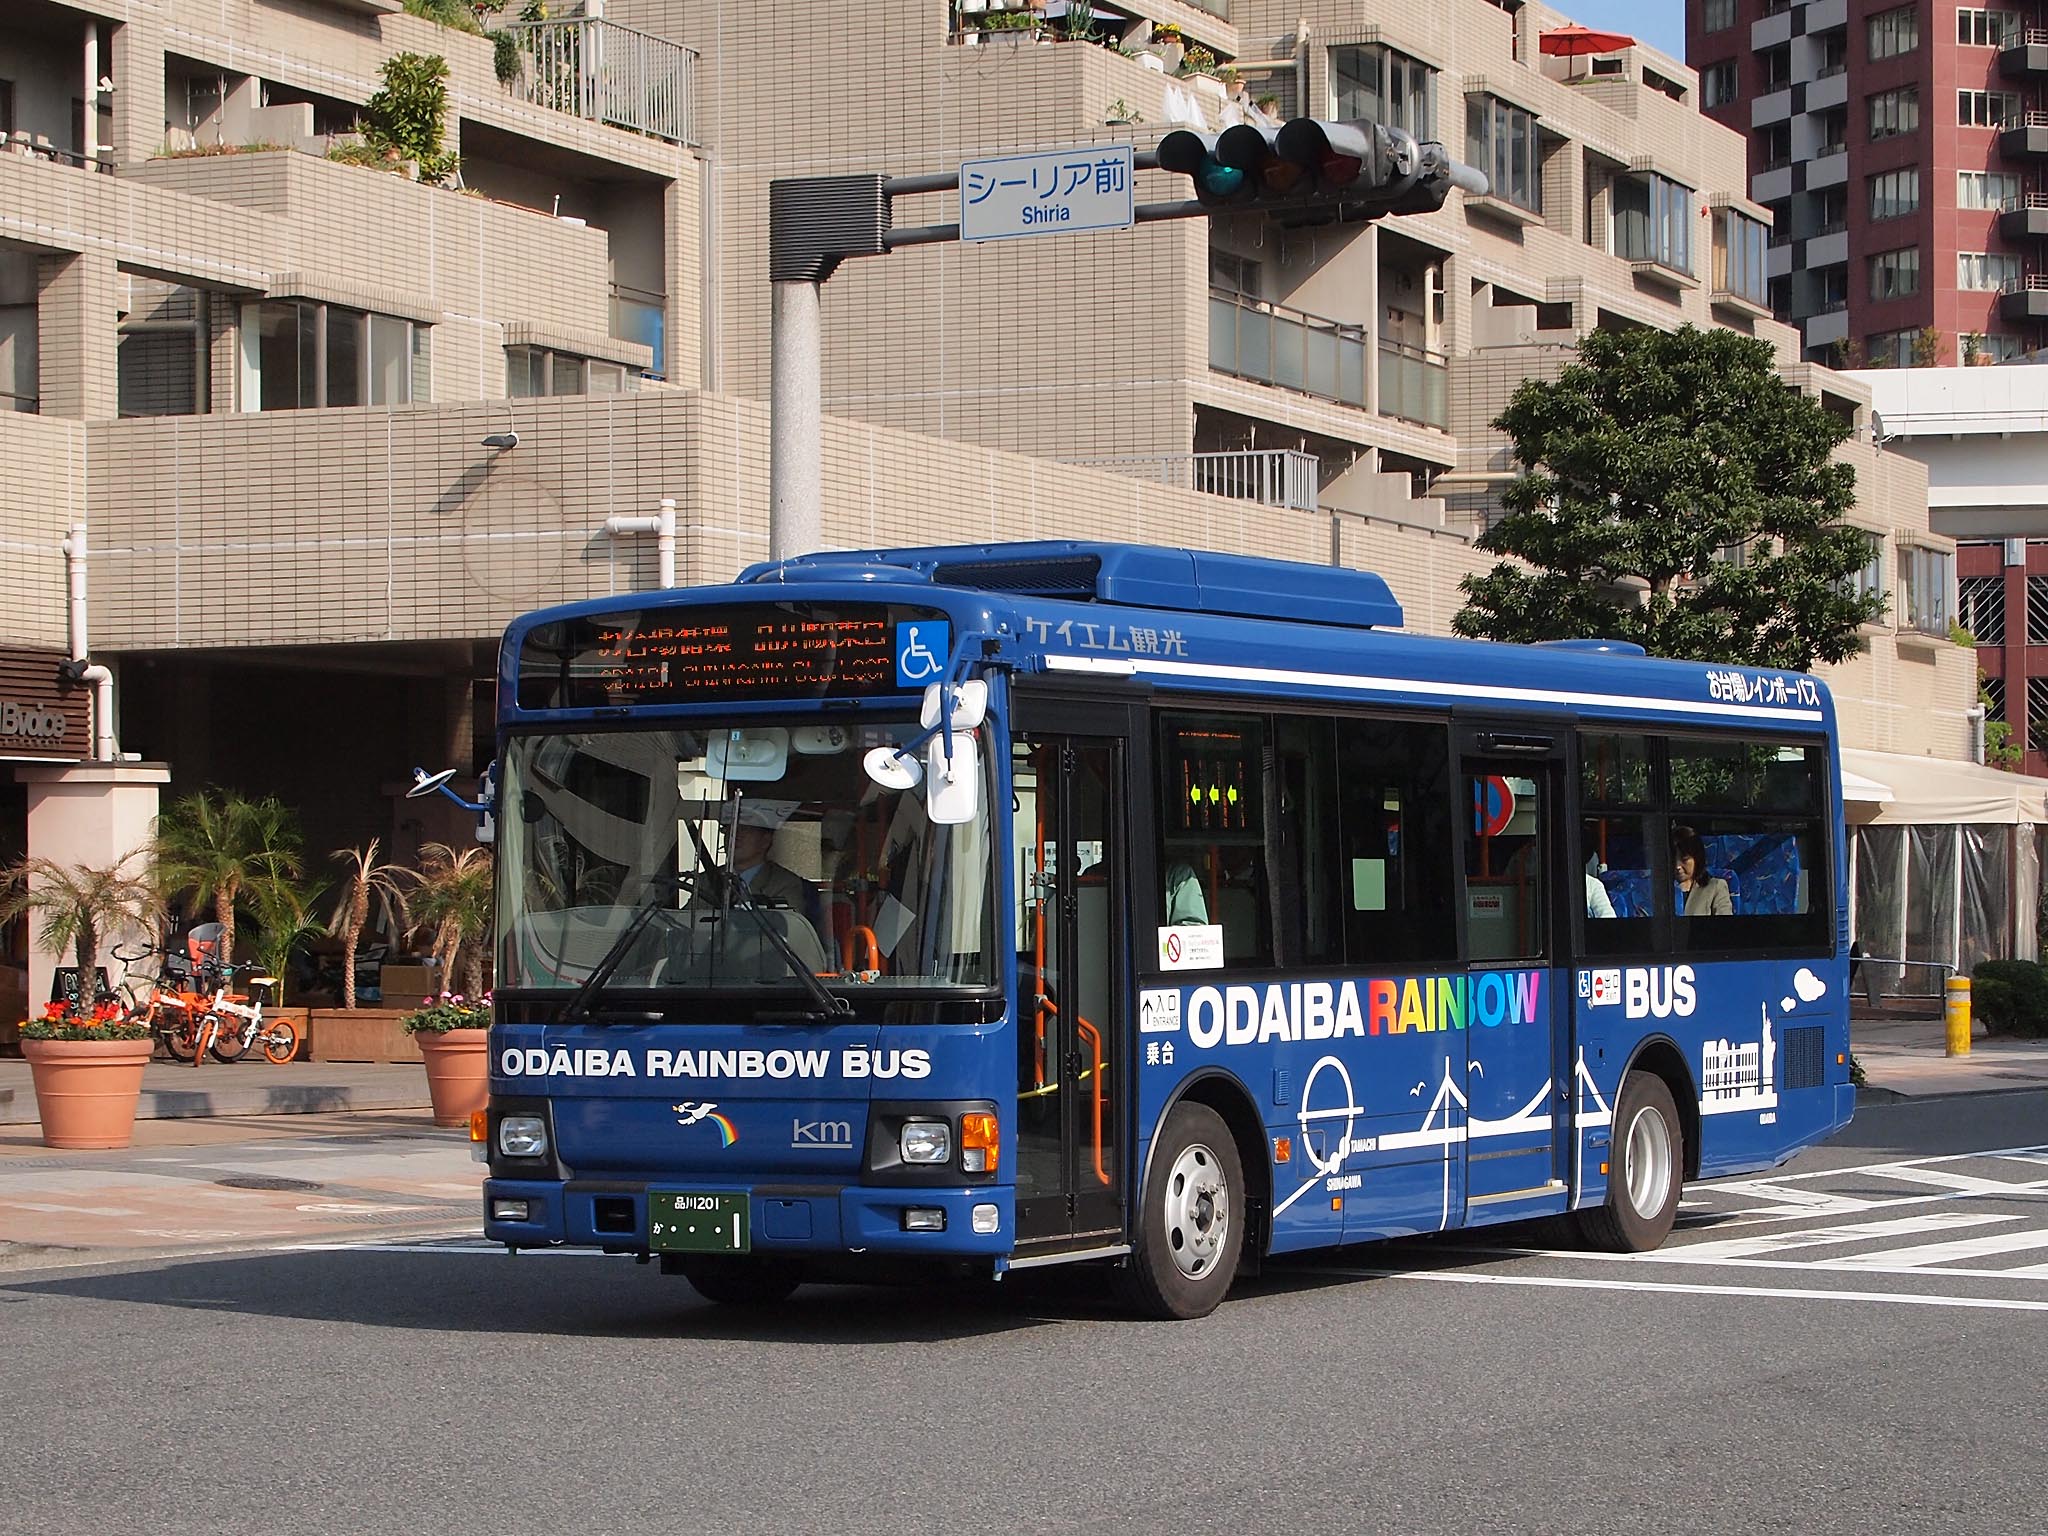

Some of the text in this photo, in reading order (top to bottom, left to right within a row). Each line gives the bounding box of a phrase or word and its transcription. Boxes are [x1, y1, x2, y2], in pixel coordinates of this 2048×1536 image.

[968, 158, 1125, 204] シーリア前
[1022, 203, 1070, 225] Shiria
[1026, 616, 1189, 657] ケイエム観光
[1706, 670, 1820, 707] お台場レインボーバス
[1156, 995, 1177, 1013] 入口
[1187, 964, 1697, 1049] ODAIBA RAINBOW BUS
[1153, 1015, 1179, 1027] ENTRANCE
[502, 1048, 931, 1080] ODAIBA RAINBOW BUS
[1146, 1040, 1174, 1066] 乗合
[793, 1118, 851, 1143] km
